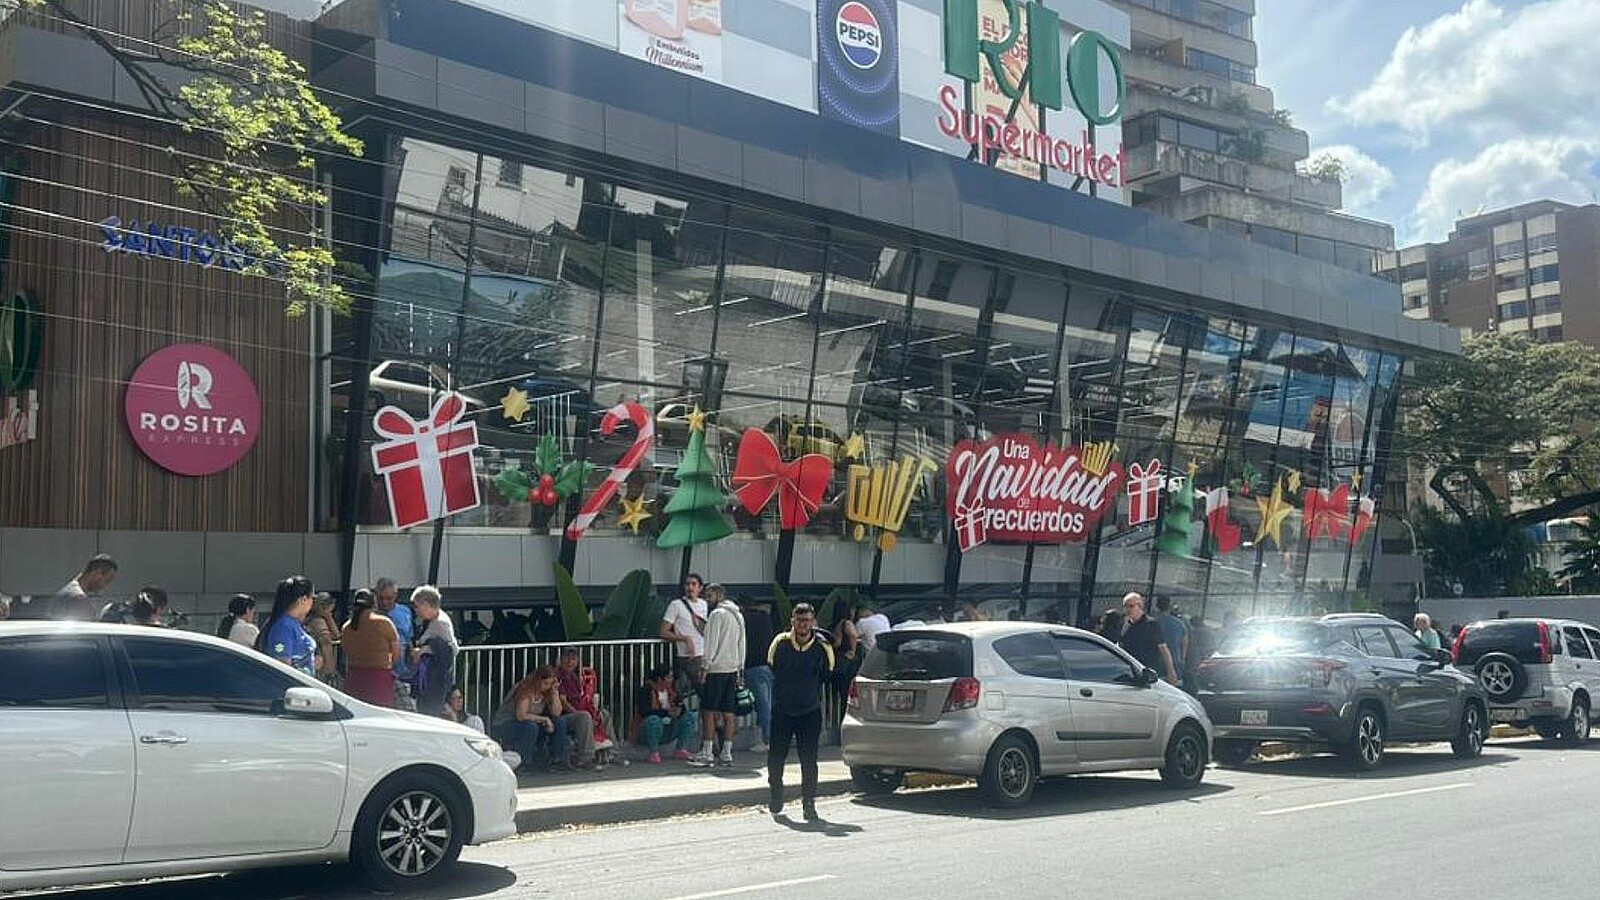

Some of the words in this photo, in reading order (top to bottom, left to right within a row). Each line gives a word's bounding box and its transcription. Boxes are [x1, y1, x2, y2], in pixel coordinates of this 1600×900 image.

[839, 22, 880, 48] PEPSI
[936, 84, 1128, 188] Supermarket
[140, 412, 247, 435] ROSITA
[1003, 438, 1030, 460] Una
[955, 445, 1118, 511] Navidad
[985, 505, 1085, 534] recuerdos
